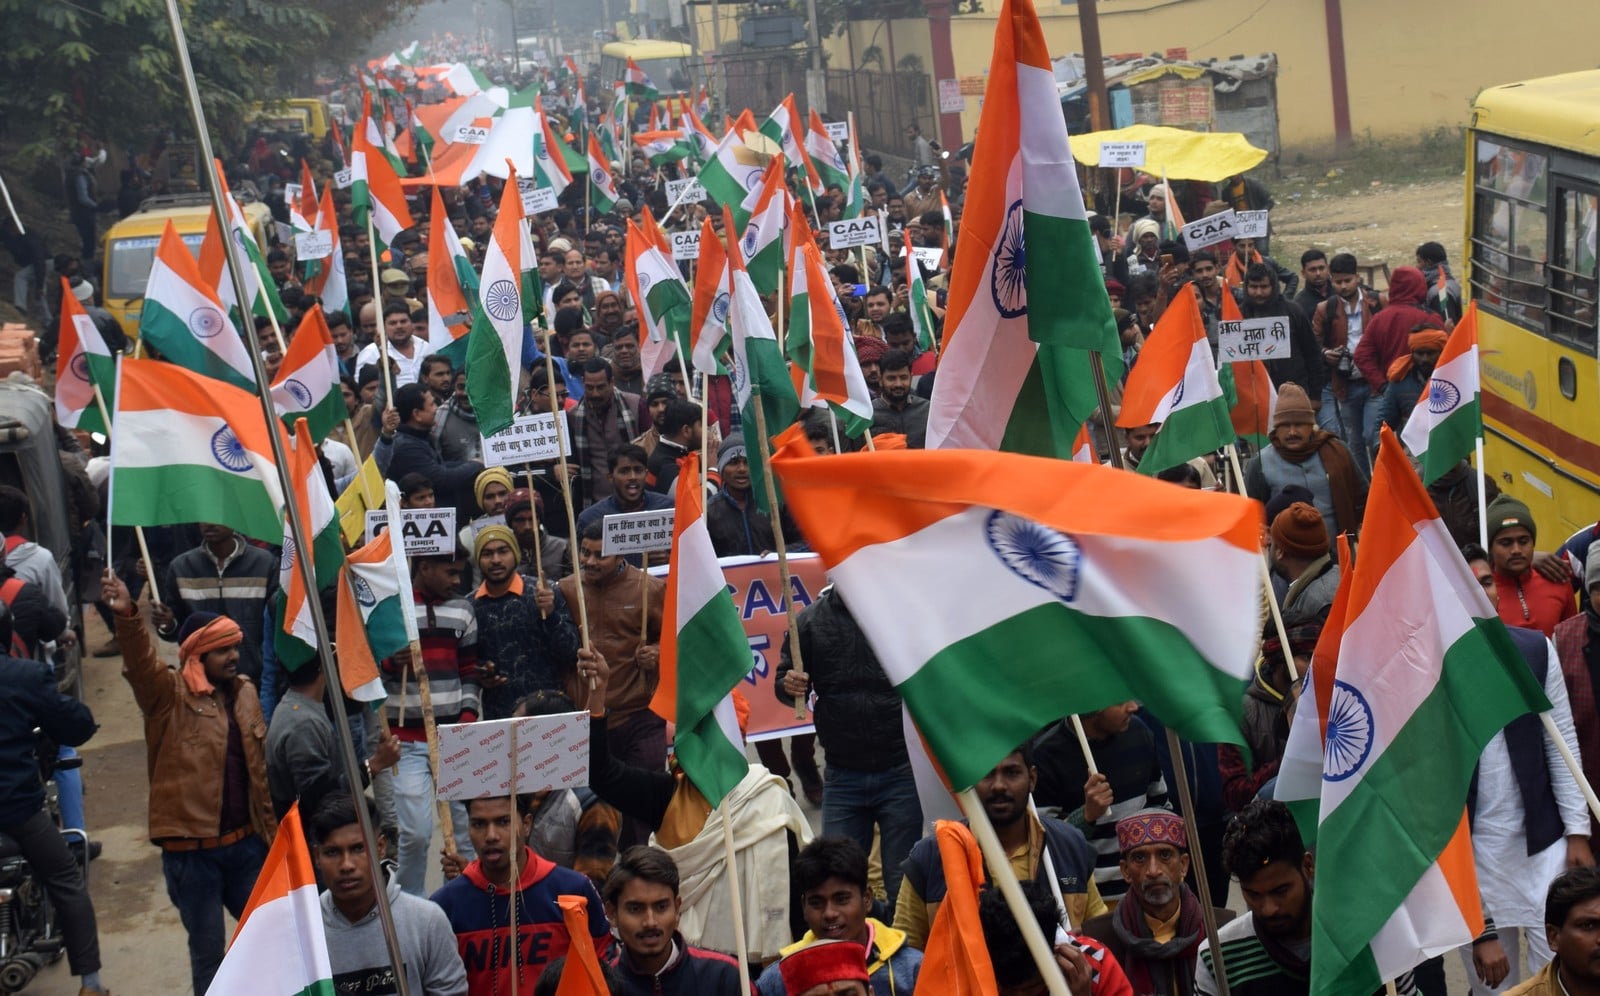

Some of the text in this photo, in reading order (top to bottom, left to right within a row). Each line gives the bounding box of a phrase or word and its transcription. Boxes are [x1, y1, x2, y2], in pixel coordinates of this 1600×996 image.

[459, 127, 486, 136] CAA
[833, 220, 875, 235] CAA
[1190, 220, 1232, 239] CAA
[1271, 321, 1286, 341] की
[1238, 342, 1260, 356] जय
[507, 741, 533, 759] Rmond
[500, 772, 526, 789] Rayond
[464, 931, 553, 972] NIKE
